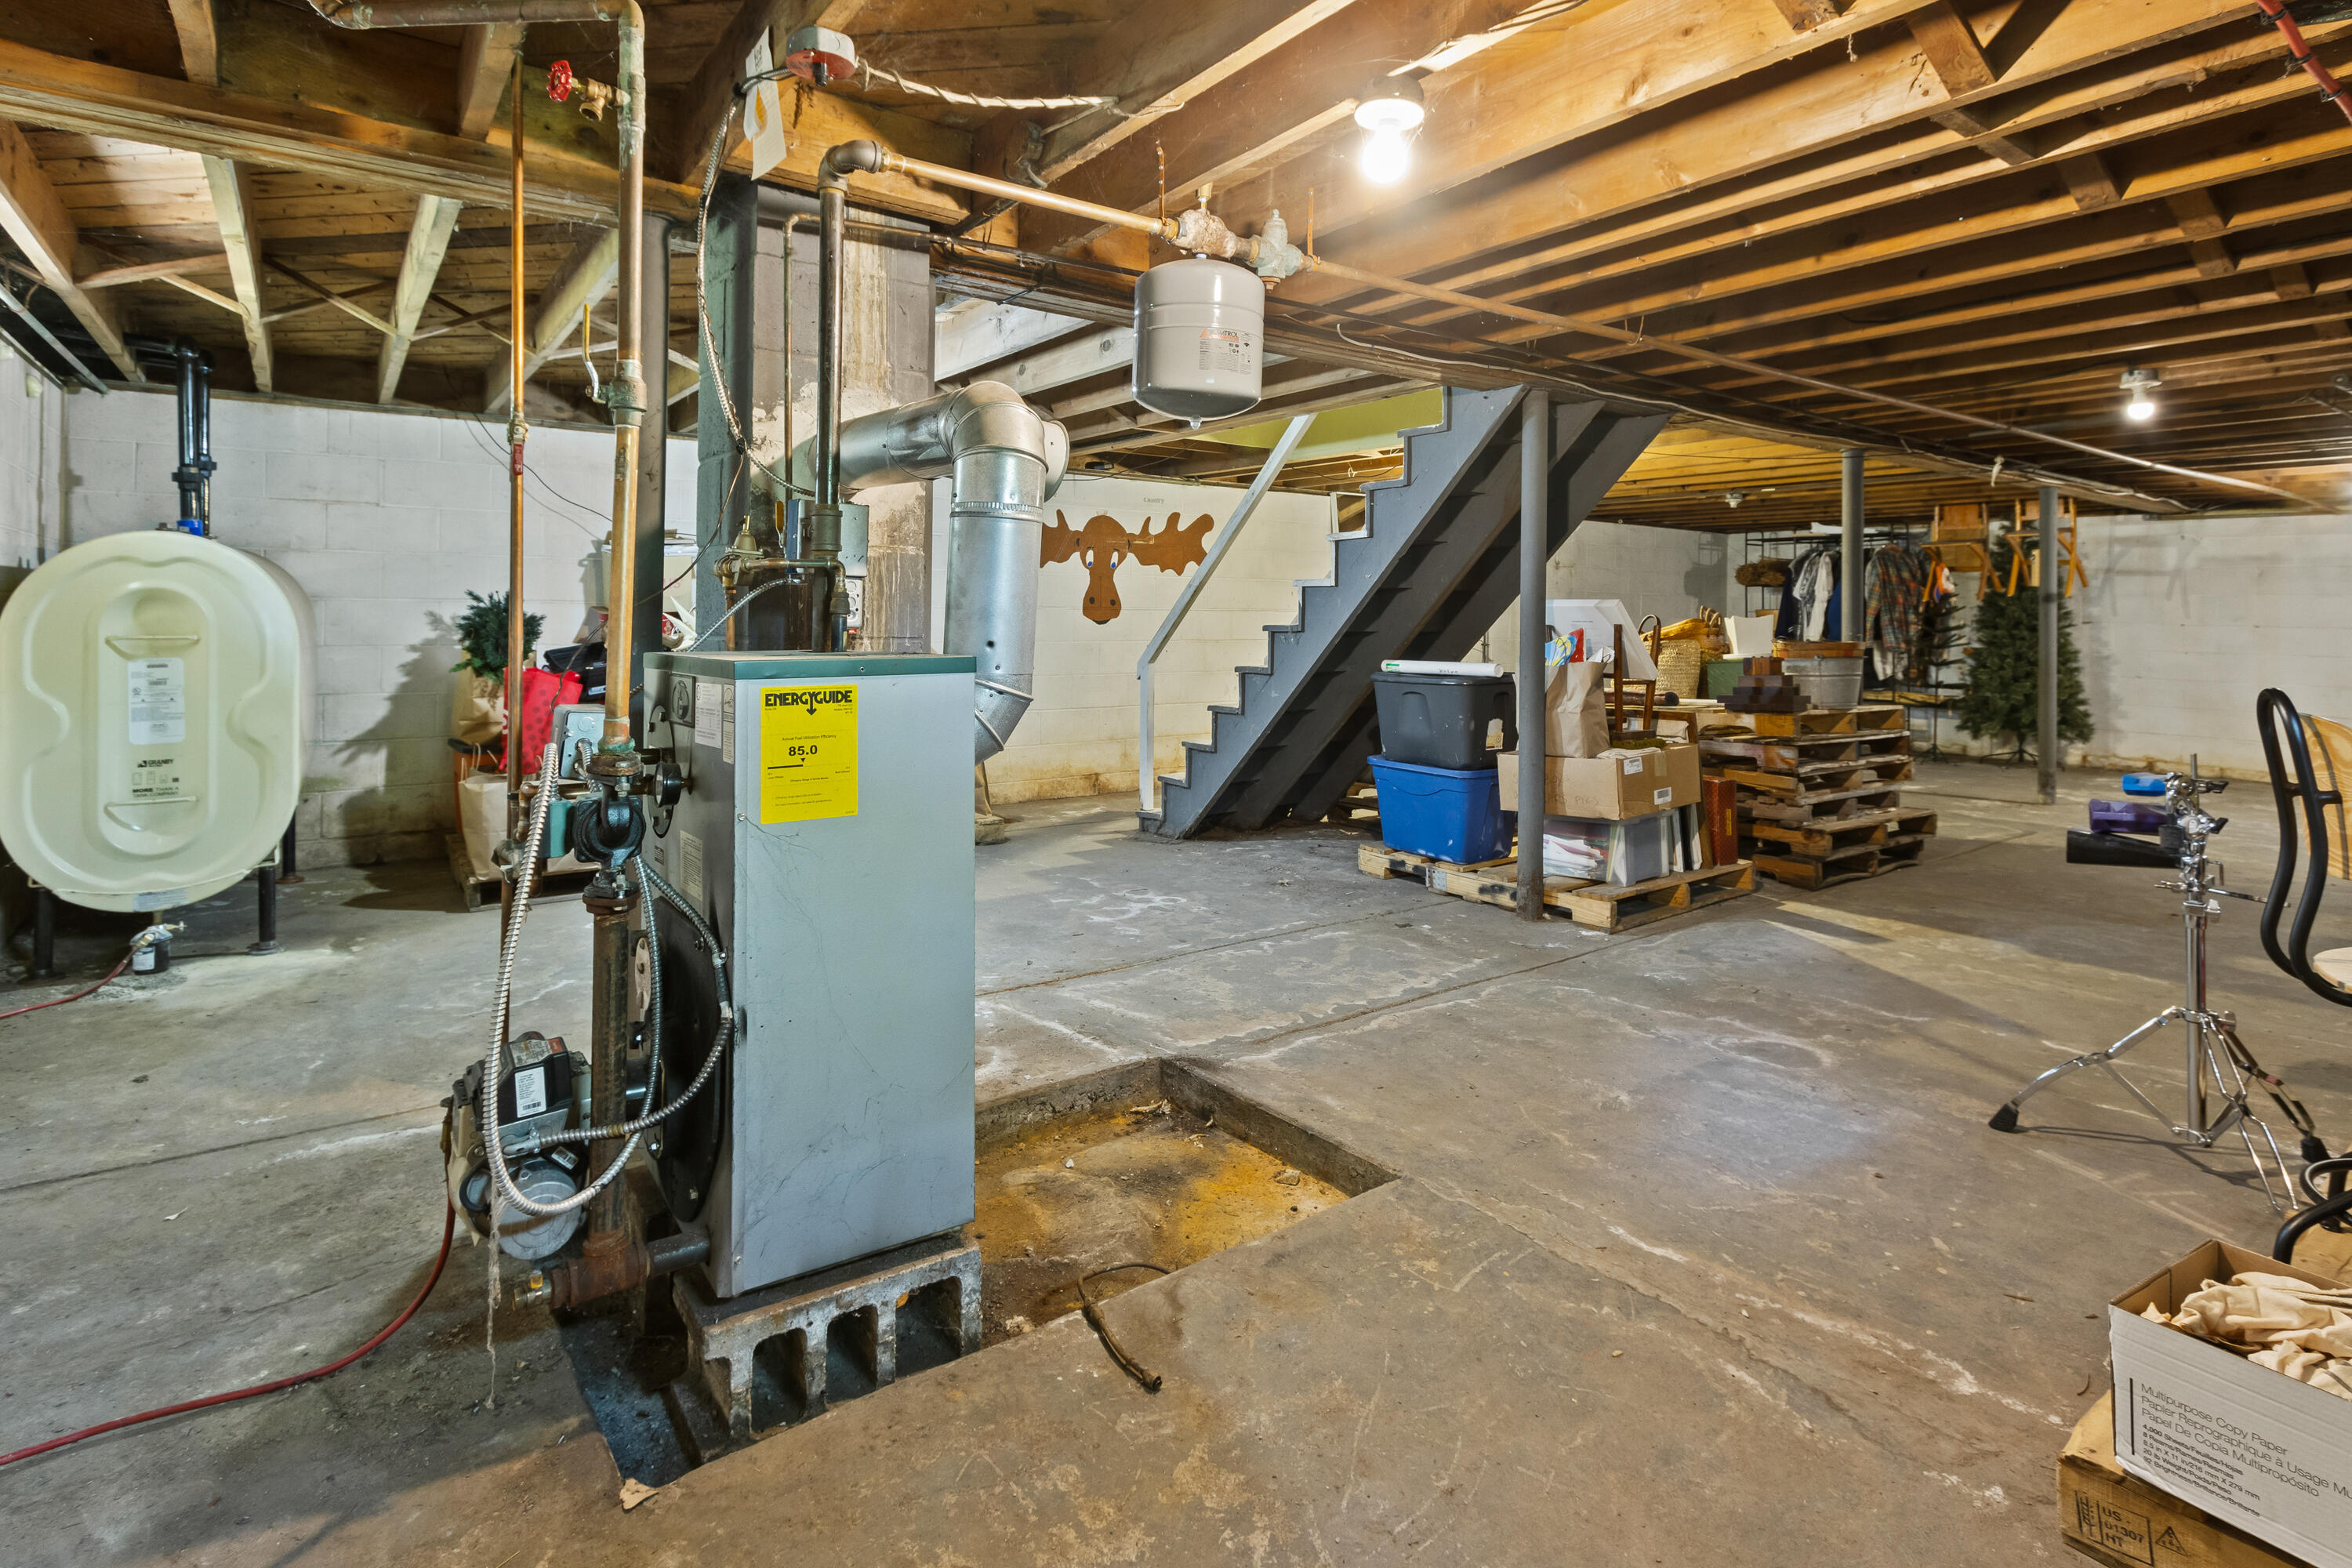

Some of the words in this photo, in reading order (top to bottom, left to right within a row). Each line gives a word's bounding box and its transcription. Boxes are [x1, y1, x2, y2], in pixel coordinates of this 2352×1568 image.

[764, 690, 853, 708] ENERGYGUIDE
[788, 745, 818, 757] 85.0
[2141, 1383, 2212, 1422] Multipurpose
[2216, 1417, 2248, 1439] Copy
[2252, 1432, 2288, 1455] Paper
[2143, 1424, 2162, 1436] 4,000
[2141, 1396, 2176, 1417] Papier
[2179, 1412, 2271, 1461] Reprographique
[2275, 1457, 2283, 1468] à
[2287, 1461, 2329, 1487] Usage
[2141, 1407, 2172, 1428] Papel
[2176, 1423, 2191, 1438] De
[2194, 1432, 2229, 1455] Copia
[2233, 1450, 2319, 1496] Multipropósito
[2143, 1439, 2154, 1449] 8.5
[2205, 1470, 2220, 1481] mm
[2229, 1481, 2243, 1492] 279
[2245, 1490, 2260, 1501] mm
[2102, 1506, 2122, 1522] US
[2105, 1532, 2122, 1548] HT
